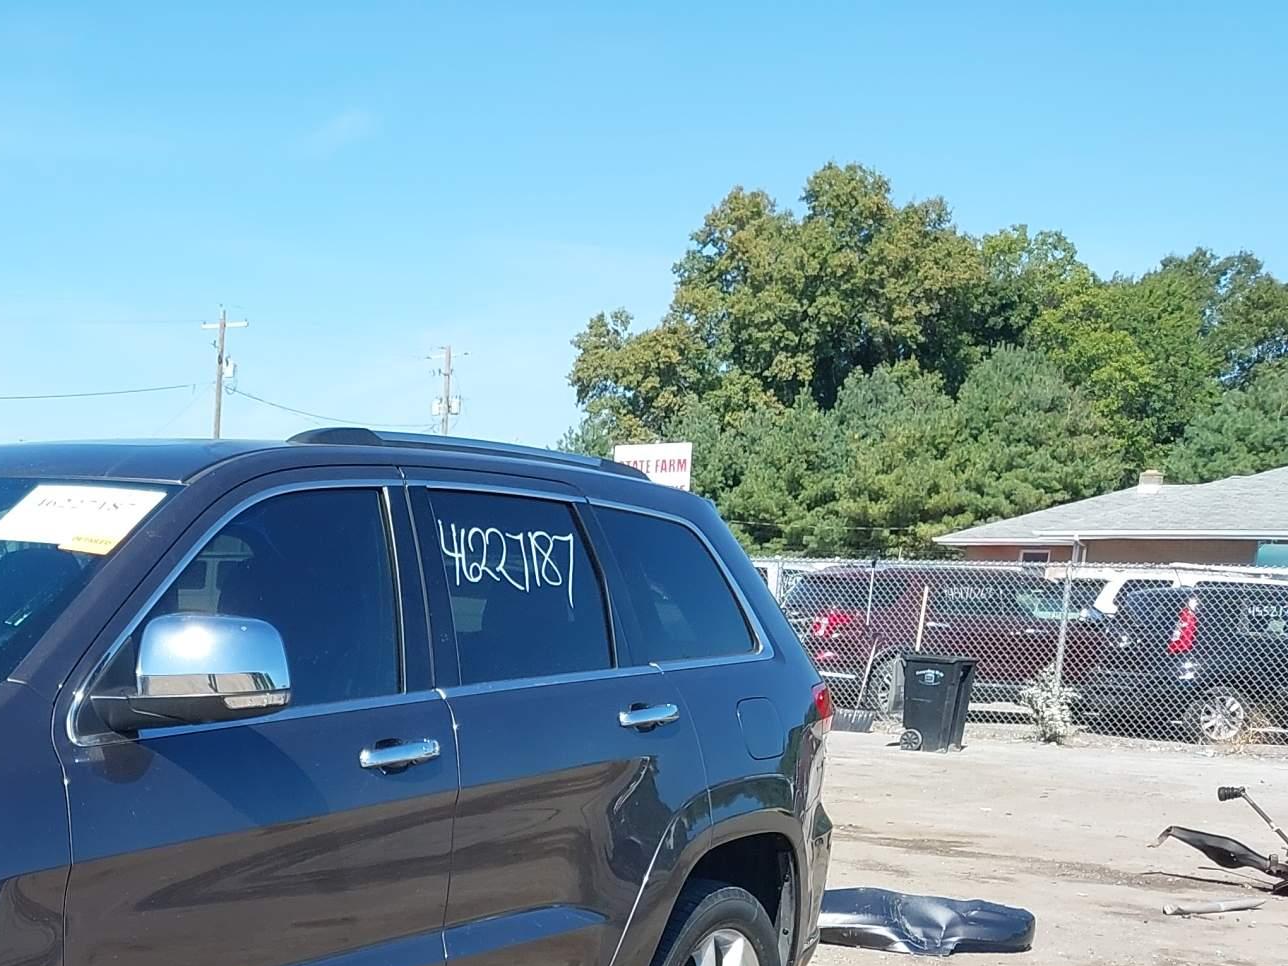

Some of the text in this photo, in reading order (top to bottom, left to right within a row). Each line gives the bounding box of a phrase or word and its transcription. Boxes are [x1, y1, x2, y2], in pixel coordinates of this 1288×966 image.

[620, 459, 688, 474] TATE FARM
[437, 519, 575, 609] 46227187
